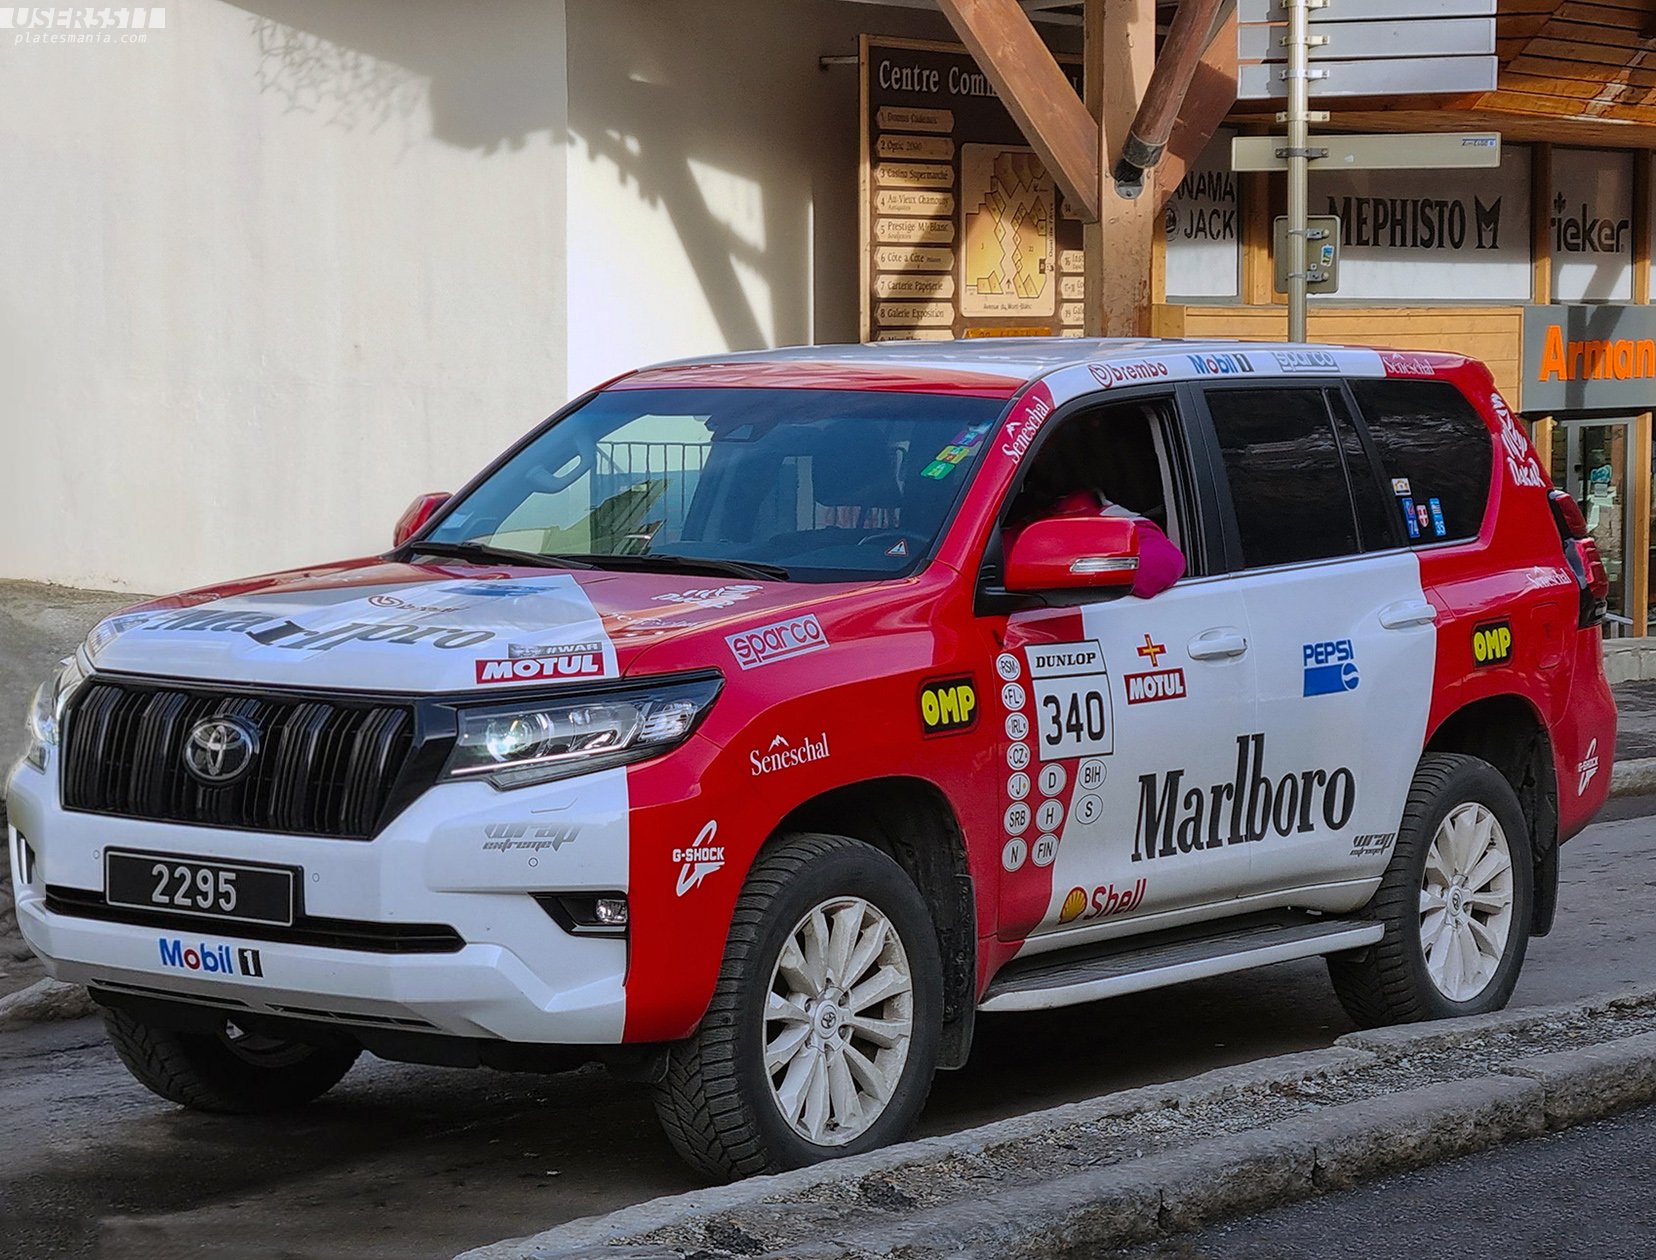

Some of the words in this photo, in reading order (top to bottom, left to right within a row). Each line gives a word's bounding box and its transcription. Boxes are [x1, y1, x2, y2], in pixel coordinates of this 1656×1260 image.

[879, 60, 940, 93] Centre
[880, 168, 885, 178] 3
[1176, 170, 1236, 203] NAMA
[880, 224, 886, 235] 5
[1183, 208, 1236, 240] JACK
[1327, 196, 1466, 250] MEPHISTO
[880, 252, 886, 263] 6
[880, 281, 885, 290] 7
[880, 308, 886, 319] 8
[1274, 351, 1335, 371] sparco
[1538, 324, 1656, 382] Arman
[1106, 359, 1169, 381] brembo
[1187, 354, 1239, 374] Mobil
[1001, 395, 1051, 465] Seneschal
[733, 619, 821, 661] sparco
[1473, 626, 1512, 662] OMP
[1036, 652, 1096, 668] DUNLOP
[1303, 638, 1355, 666] PEPSI
[481, 654, 600, 681] MOTUL
[1001, 659, 1016, 674] RSM
[1129, 672, 1185, 701] MOTUL
[921, 685, 976, 726] OMP
[1008, 688, 1020, 706] FL
[1042, 690, 1105, 746] 340
[749, 732, 831, 776] Seneschal
[1012, 748, 1025, 765] CZ
[1047, 772, 1057, 789] D
[1084, 766, 1102, 784] BIH
[1015, 776, 1023, 796] J
[1131, 732, 1356, 862] Marlboro
[1008, 809, 1027, 823] SRB
[1045, 807, 1054, 825] H
[1084, 801, 1093, 818] S
[672, 846, 725, 862] G-SHOCK
[1010, 845, 1019, 864] N
[1036, 841, 1053, 860] FIN
[151, 863, 237, 912] 2295
[1083, 877, 1147, 921] Shell
[159, 938, 234, 975] Mobil
[240, 948, 261, 977] 1
